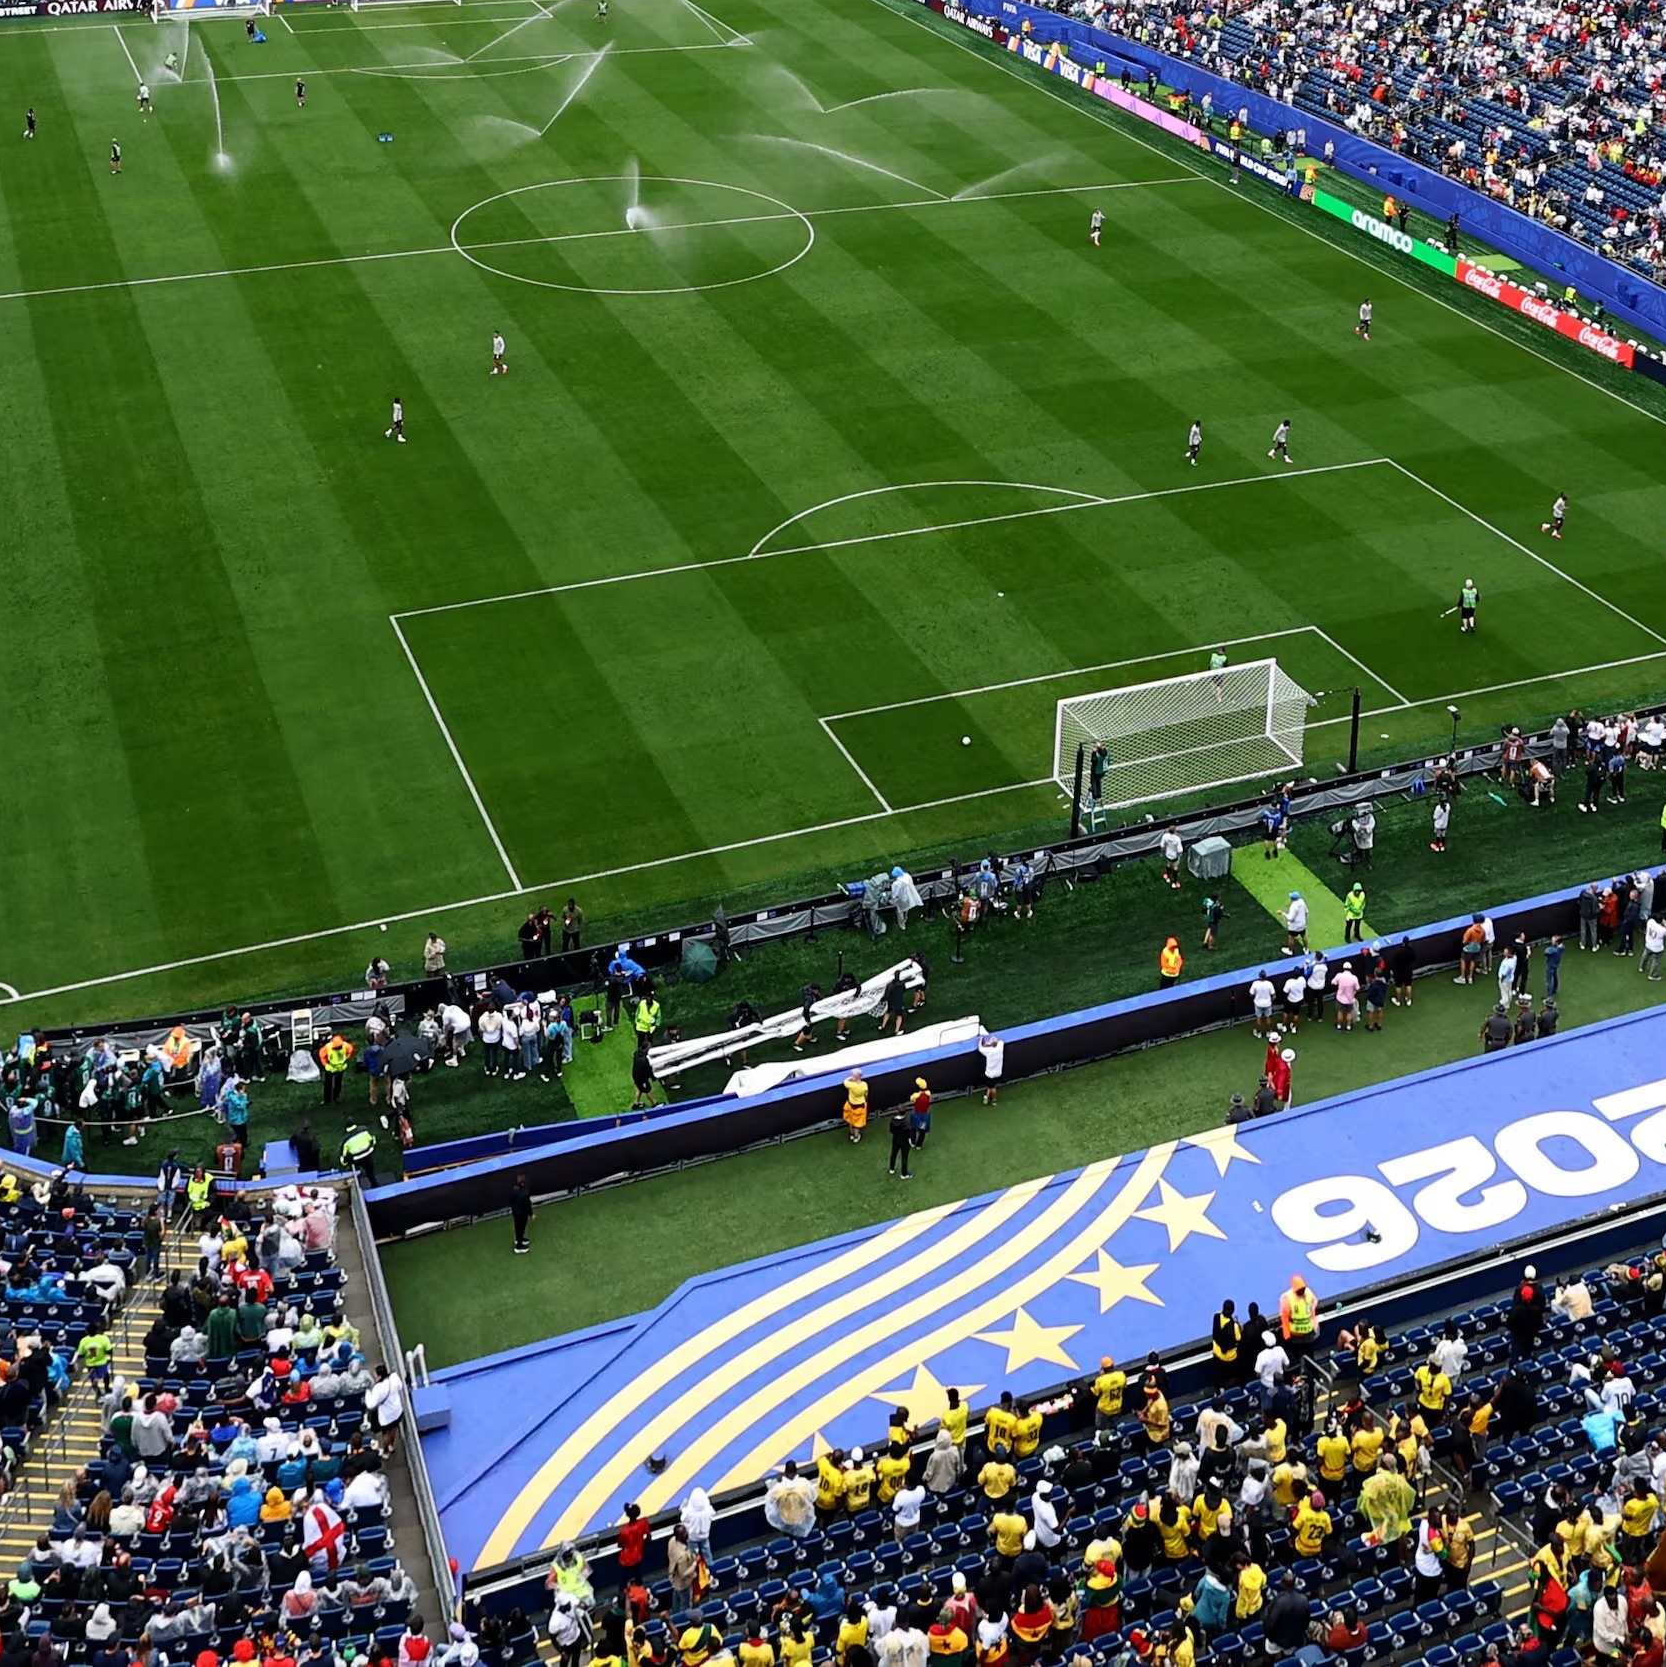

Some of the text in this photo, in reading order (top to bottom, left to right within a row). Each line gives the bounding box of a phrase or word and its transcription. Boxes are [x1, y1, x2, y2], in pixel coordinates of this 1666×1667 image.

[943, 4, 994, 39] QATAR AIRWAYS
[1002, 1, 1017, 14] FIFA
[1022, 38, 1042, 65] VISA
[1059, 58, 1080, 83] VISA
[1464, 268, 1501, 298] Coca-Cola
[1520, 295, 1557, 328] Coca-Cola
[1578, 326, 1619, 360] Coca-Cola
